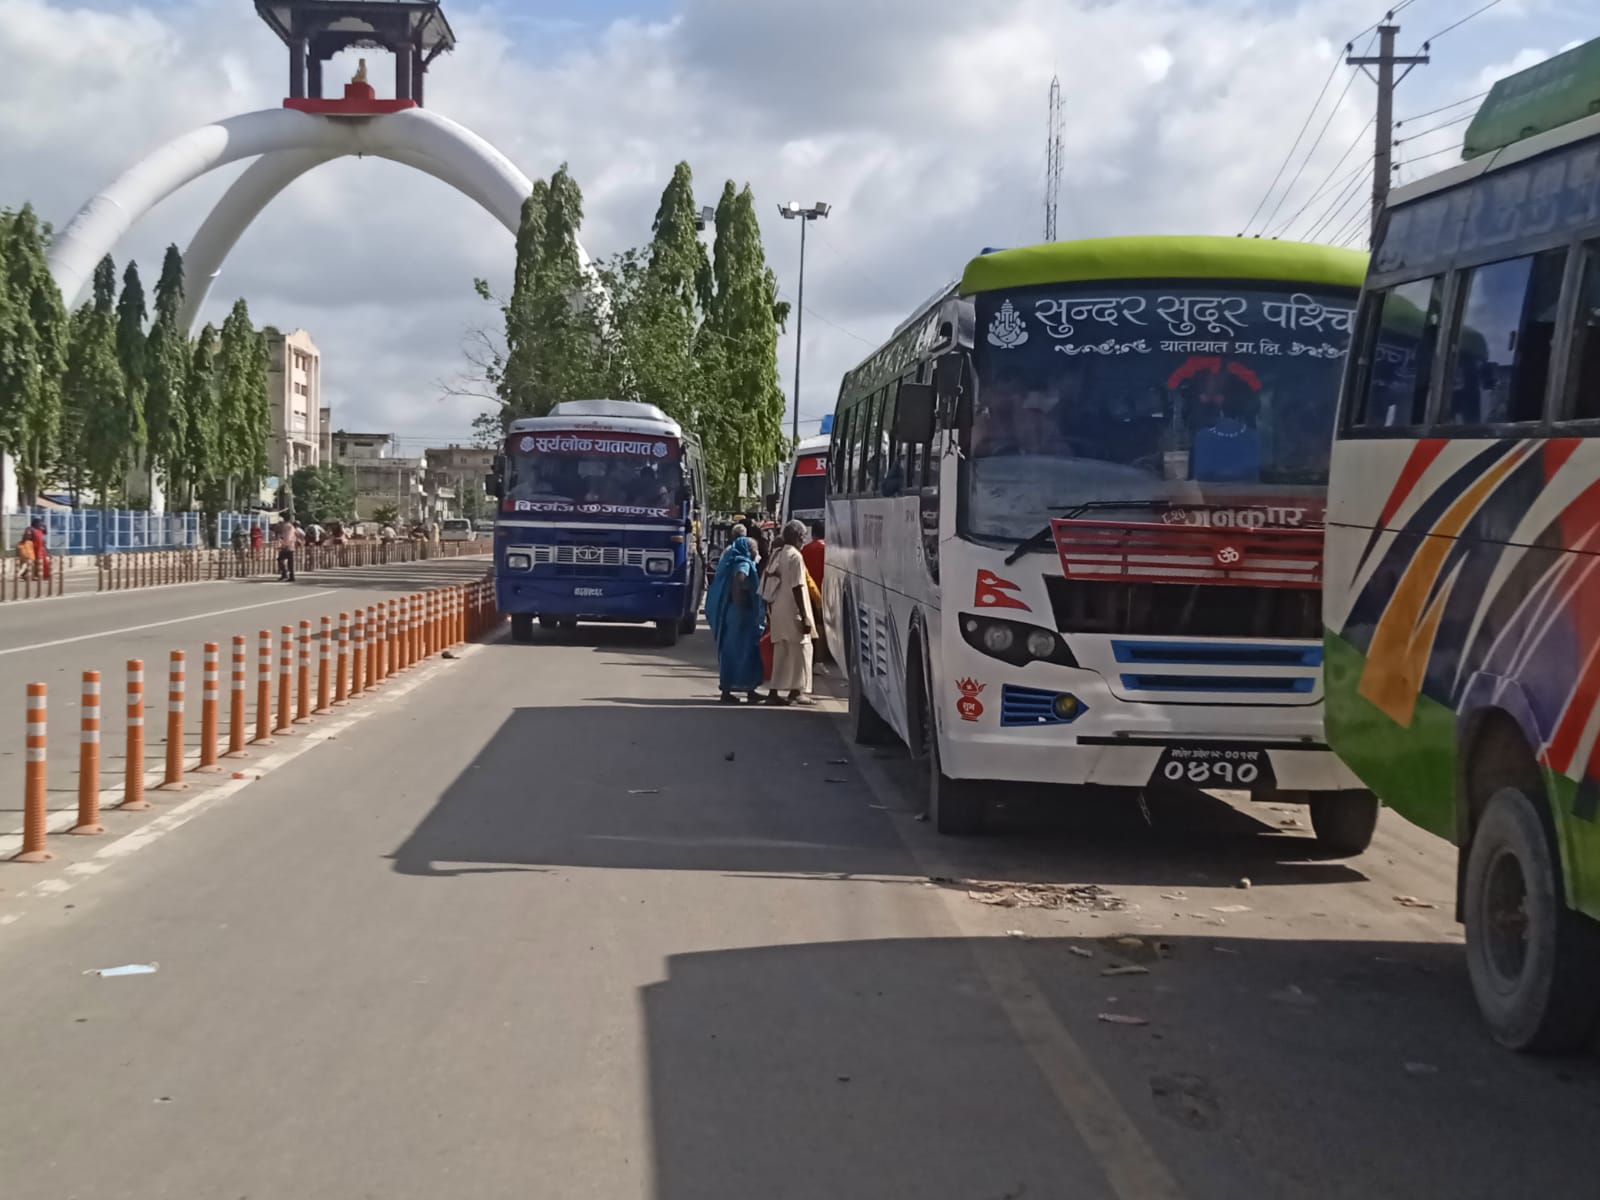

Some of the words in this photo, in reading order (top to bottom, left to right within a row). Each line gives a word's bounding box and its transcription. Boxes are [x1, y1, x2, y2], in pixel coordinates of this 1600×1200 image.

[1034, 295, 1148, 338] सुन्दर
[1156, 296, 1248, 337] सुदूर
[1261, 293, 1358, 334] पश्चि
[1159, 339, 1227, 353] यातायात
[535, 434, 592, 452] सूर्यलोक
[594, 438, 652, 455] यातायात
[1164, 760, 1258, 783] ०४१०
